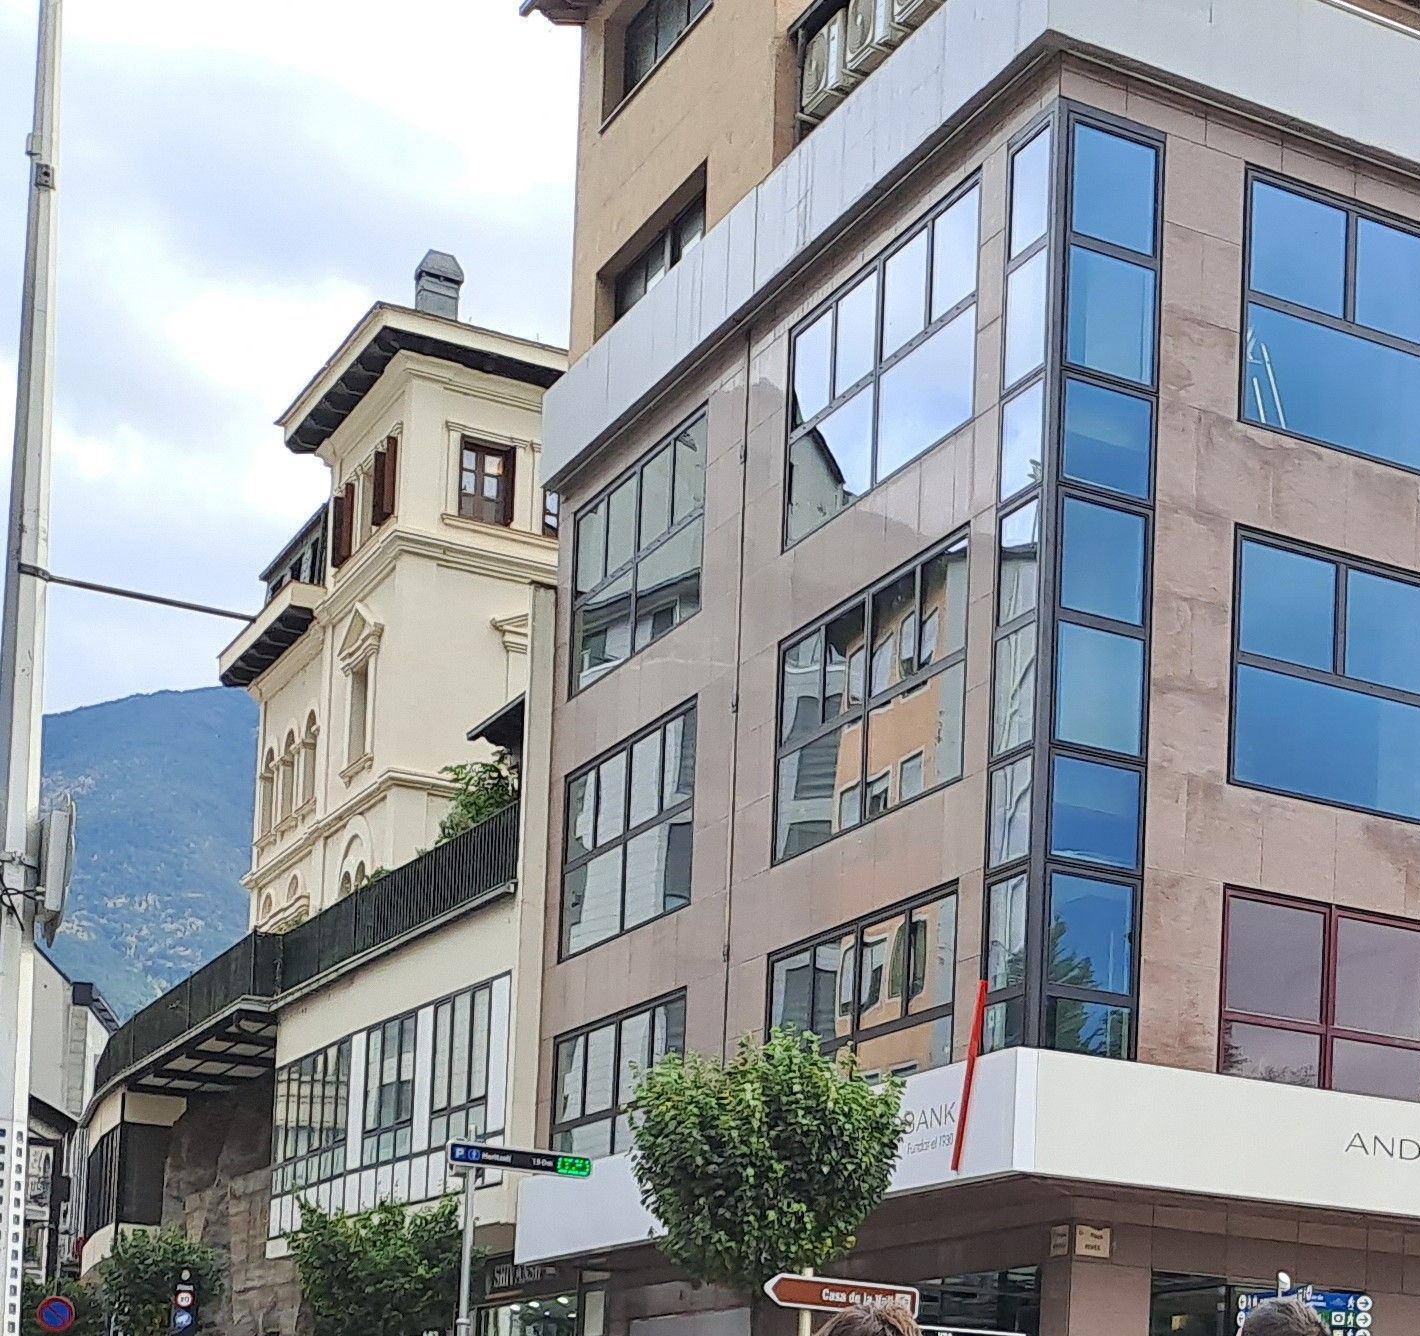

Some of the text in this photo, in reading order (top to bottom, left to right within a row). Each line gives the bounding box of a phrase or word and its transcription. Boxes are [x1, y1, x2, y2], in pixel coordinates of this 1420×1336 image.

[903, 1102, 956, 1134] BANK
[822, 1288, 847, 1303] Casa
[848, 1291, 861, 1305] de
